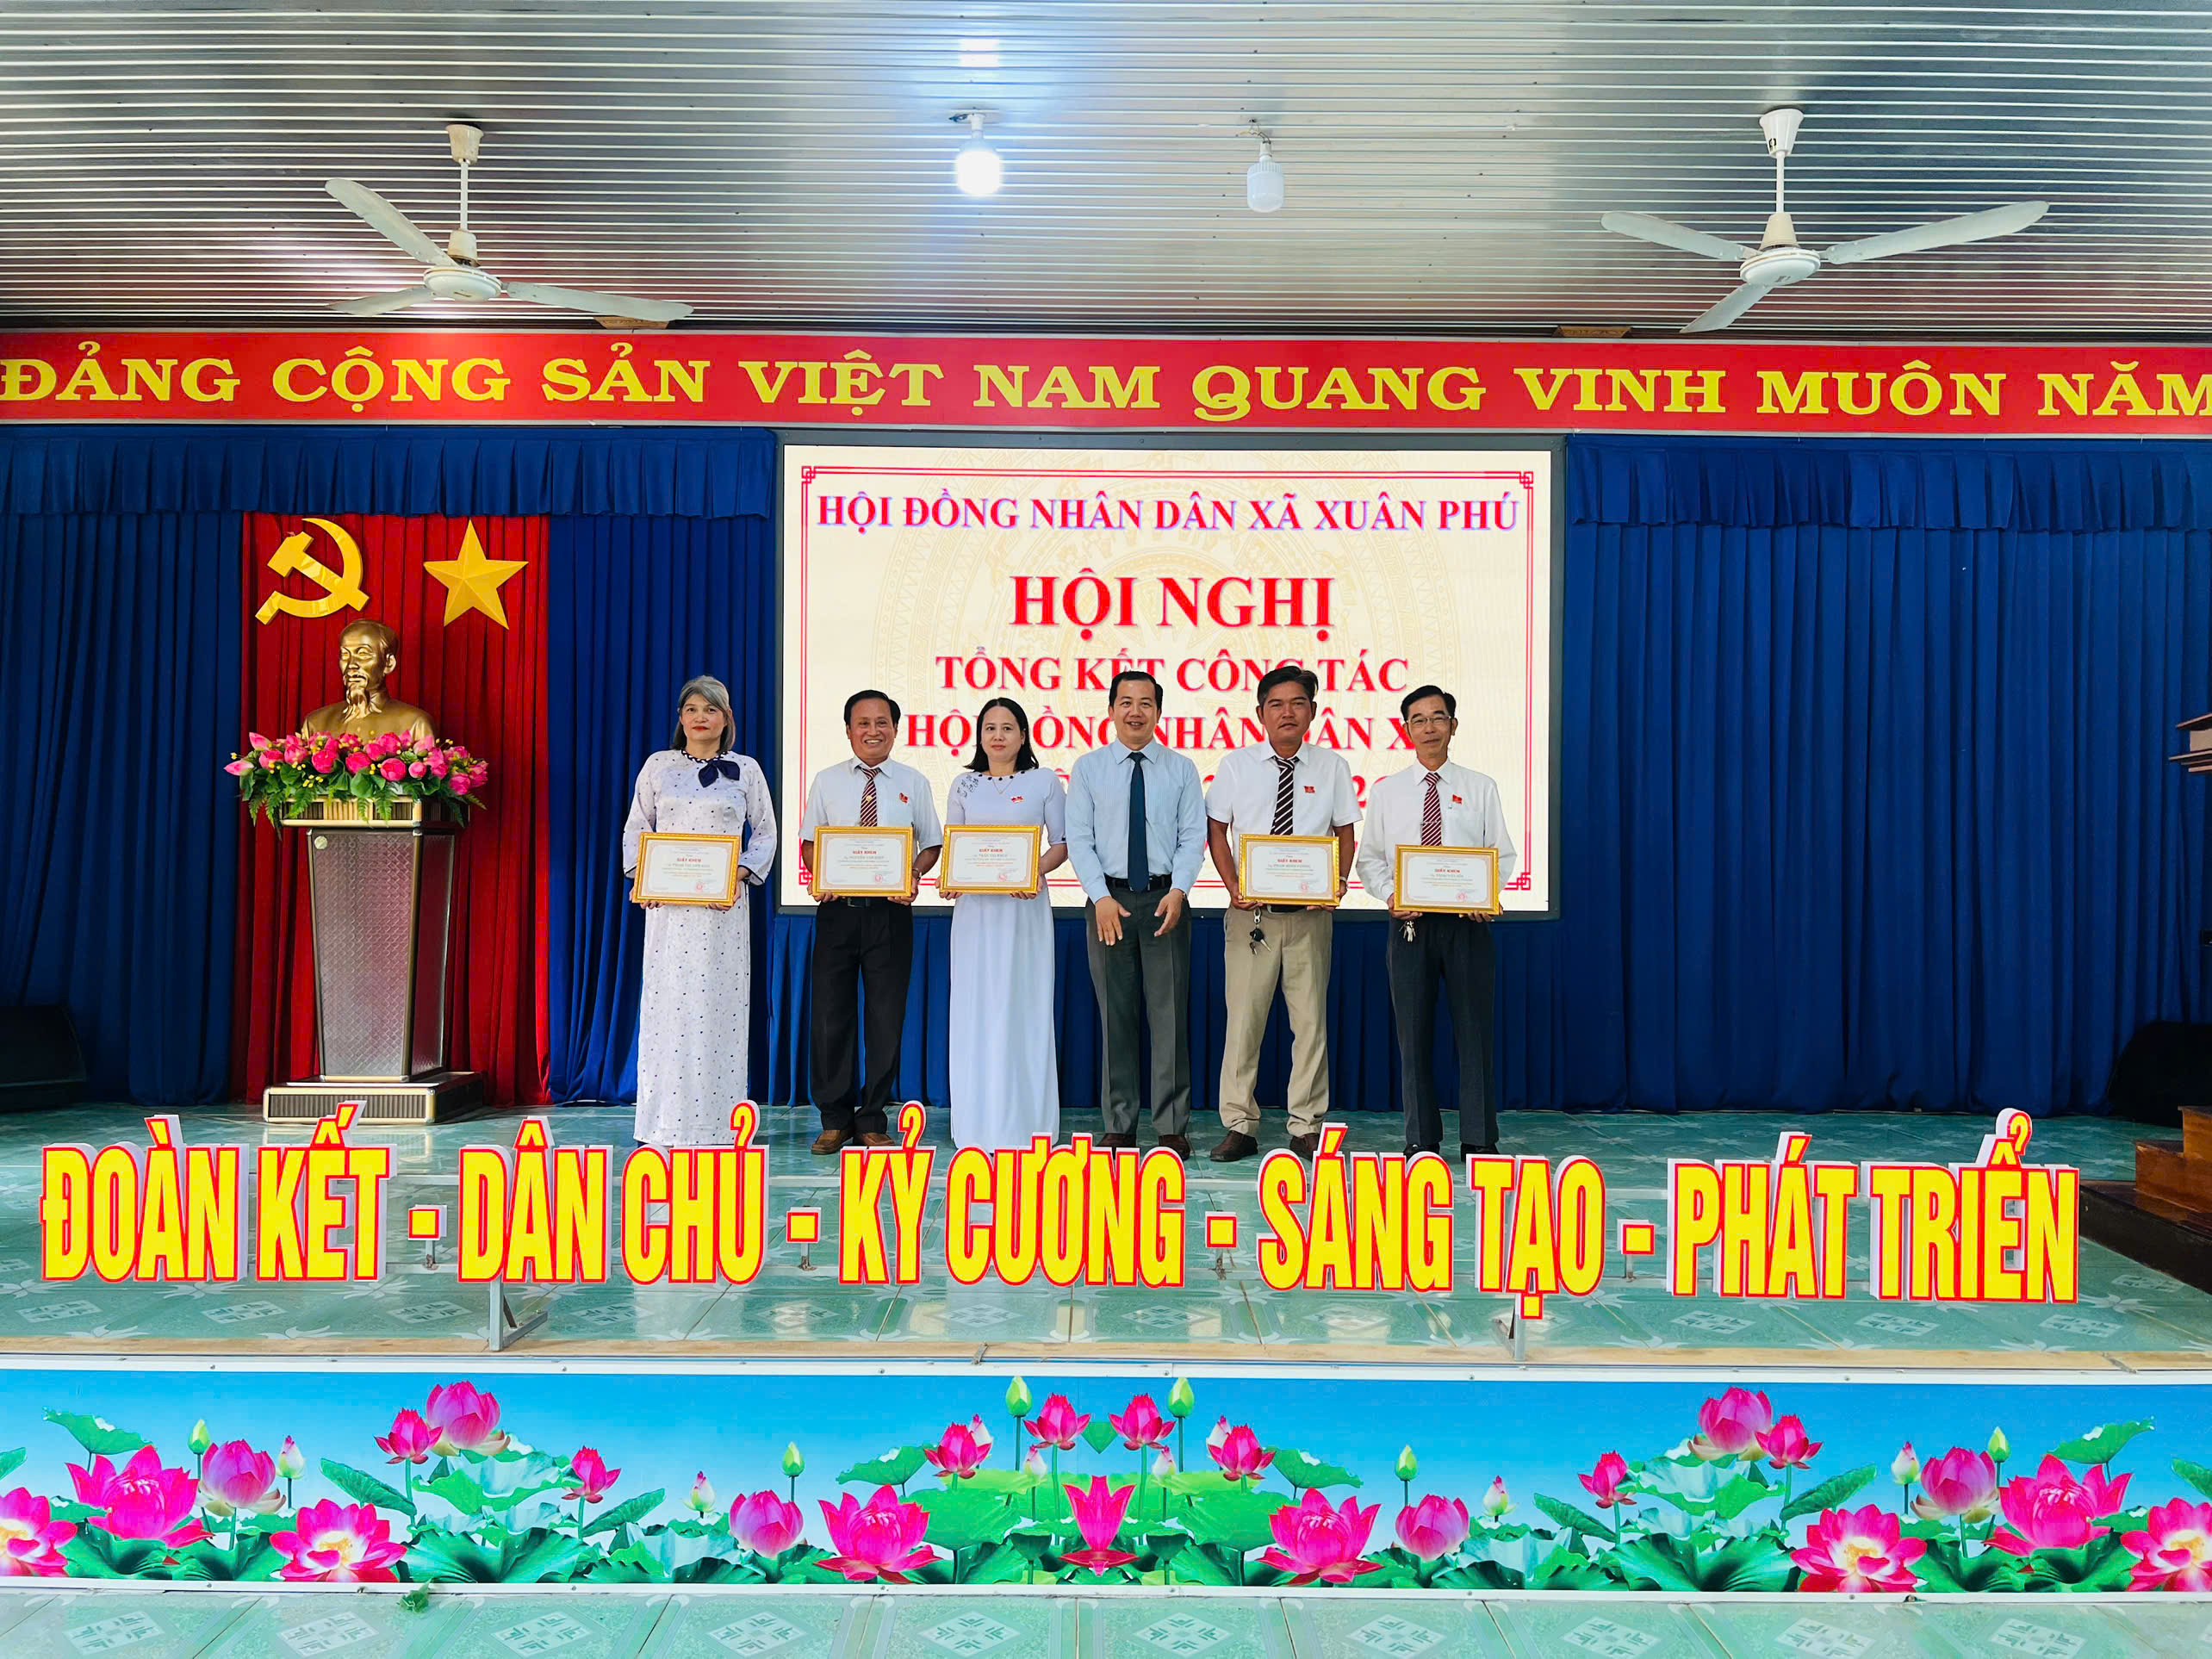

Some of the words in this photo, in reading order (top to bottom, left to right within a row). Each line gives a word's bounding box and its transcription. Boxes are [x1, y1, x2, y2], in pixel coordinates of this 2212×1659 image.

[0, 341, 240, 401] ĐẢNG
[272, 345, 511, 413] CỘNG
[542, 342, 711, 402] SẢN
[738, 350, 943, 416] VIỆT
[974, 364, 1161, 409] NAM
[1192, 365, 1487, 422] QUANG
[1513, 367, 1726, 413] VINH
[1755, 359, 2006, 415] MUÔN
[2037, 361, 2212, 416] NĂM
[817, 491, 890, 535] HỘI
[903, 488, 1018, 530] ĐỒNG
[1030, 490, 1142, 530] NHÂN
[1154, 490, 1238, 531] DÂN
[1247, 492, 1303, 531] XÃ
[1314, 491, 1426, 531] XUÂN
[1438, 490, 1519, 531] PHÚ
[1010, 567, 1138, 641] HỘI
[1158, 575, 1335, 643] NGHỊ
[935, 646, 1062, 691] TỔNG
[1176, 649, 1304, 692] CÔN
[1316, 649, 1409, 693] TÁC
[904, 708, 977, 756] HỘ
[1302, 706, 1372, 749] ÂN
[39, 1117, 241, 1283] ĐOÀN
[256, 1103, 390, 1283] KẾT
[457, 1119, 608, 1284] DÂN
[621, 1102, 767, 1286] CHỦ
[838, 1103, 935, 1285] KỶ
[945, 1134, 1186, 1289] CƯƠNG
[1258, 1126, 1455, 1293] SÁNG
[1469, 1156, 1606, 1320] TẠO
[1672, 1134, 1860, 1300] PHÁT
[1869, 1111, 2080, 1305] TRIỂN
